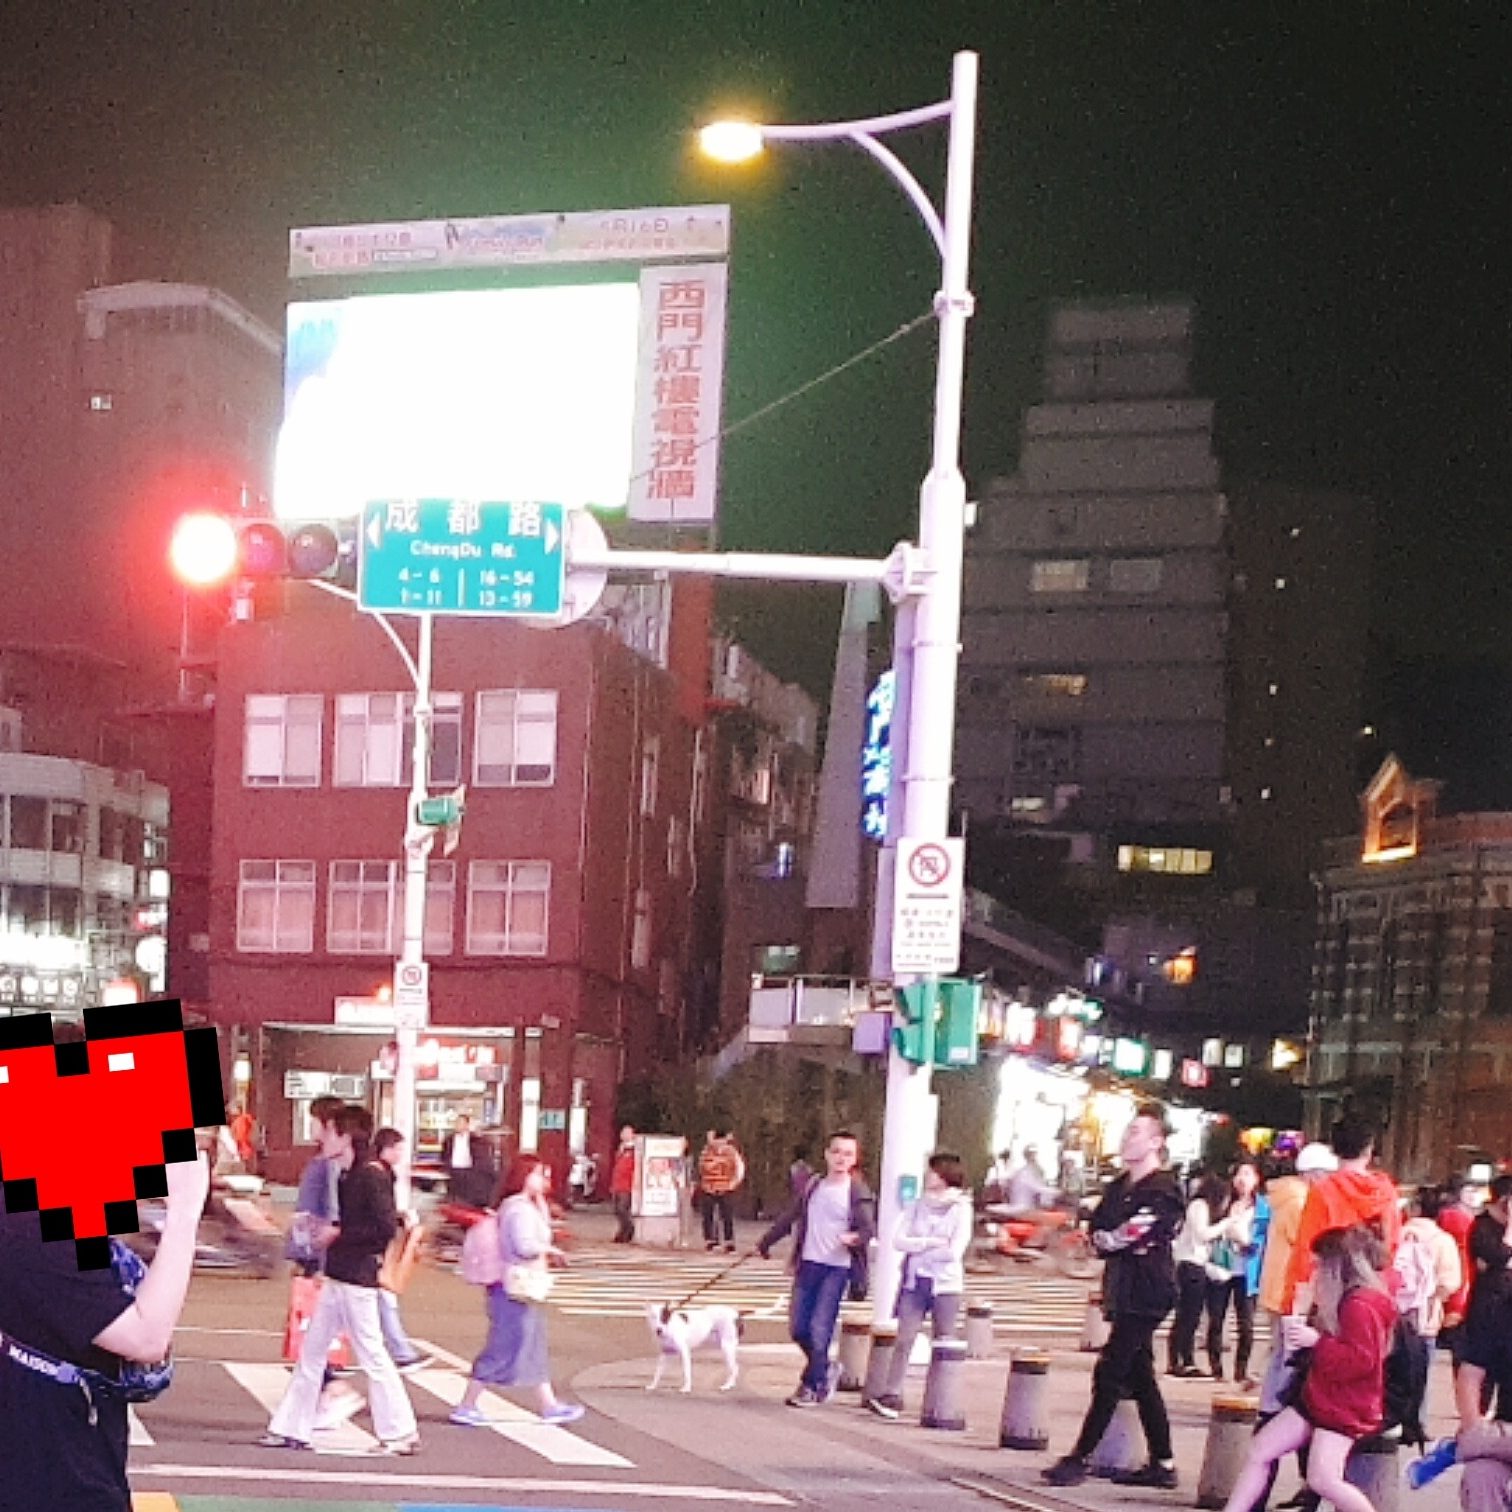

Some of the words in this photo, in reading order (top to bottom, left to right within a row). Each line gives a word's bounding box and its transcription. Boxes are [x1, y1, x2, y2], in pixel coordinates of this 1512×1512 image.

[385, 499, 542, 536] 成都路
[410, 540, 482, 560] ChengDu
